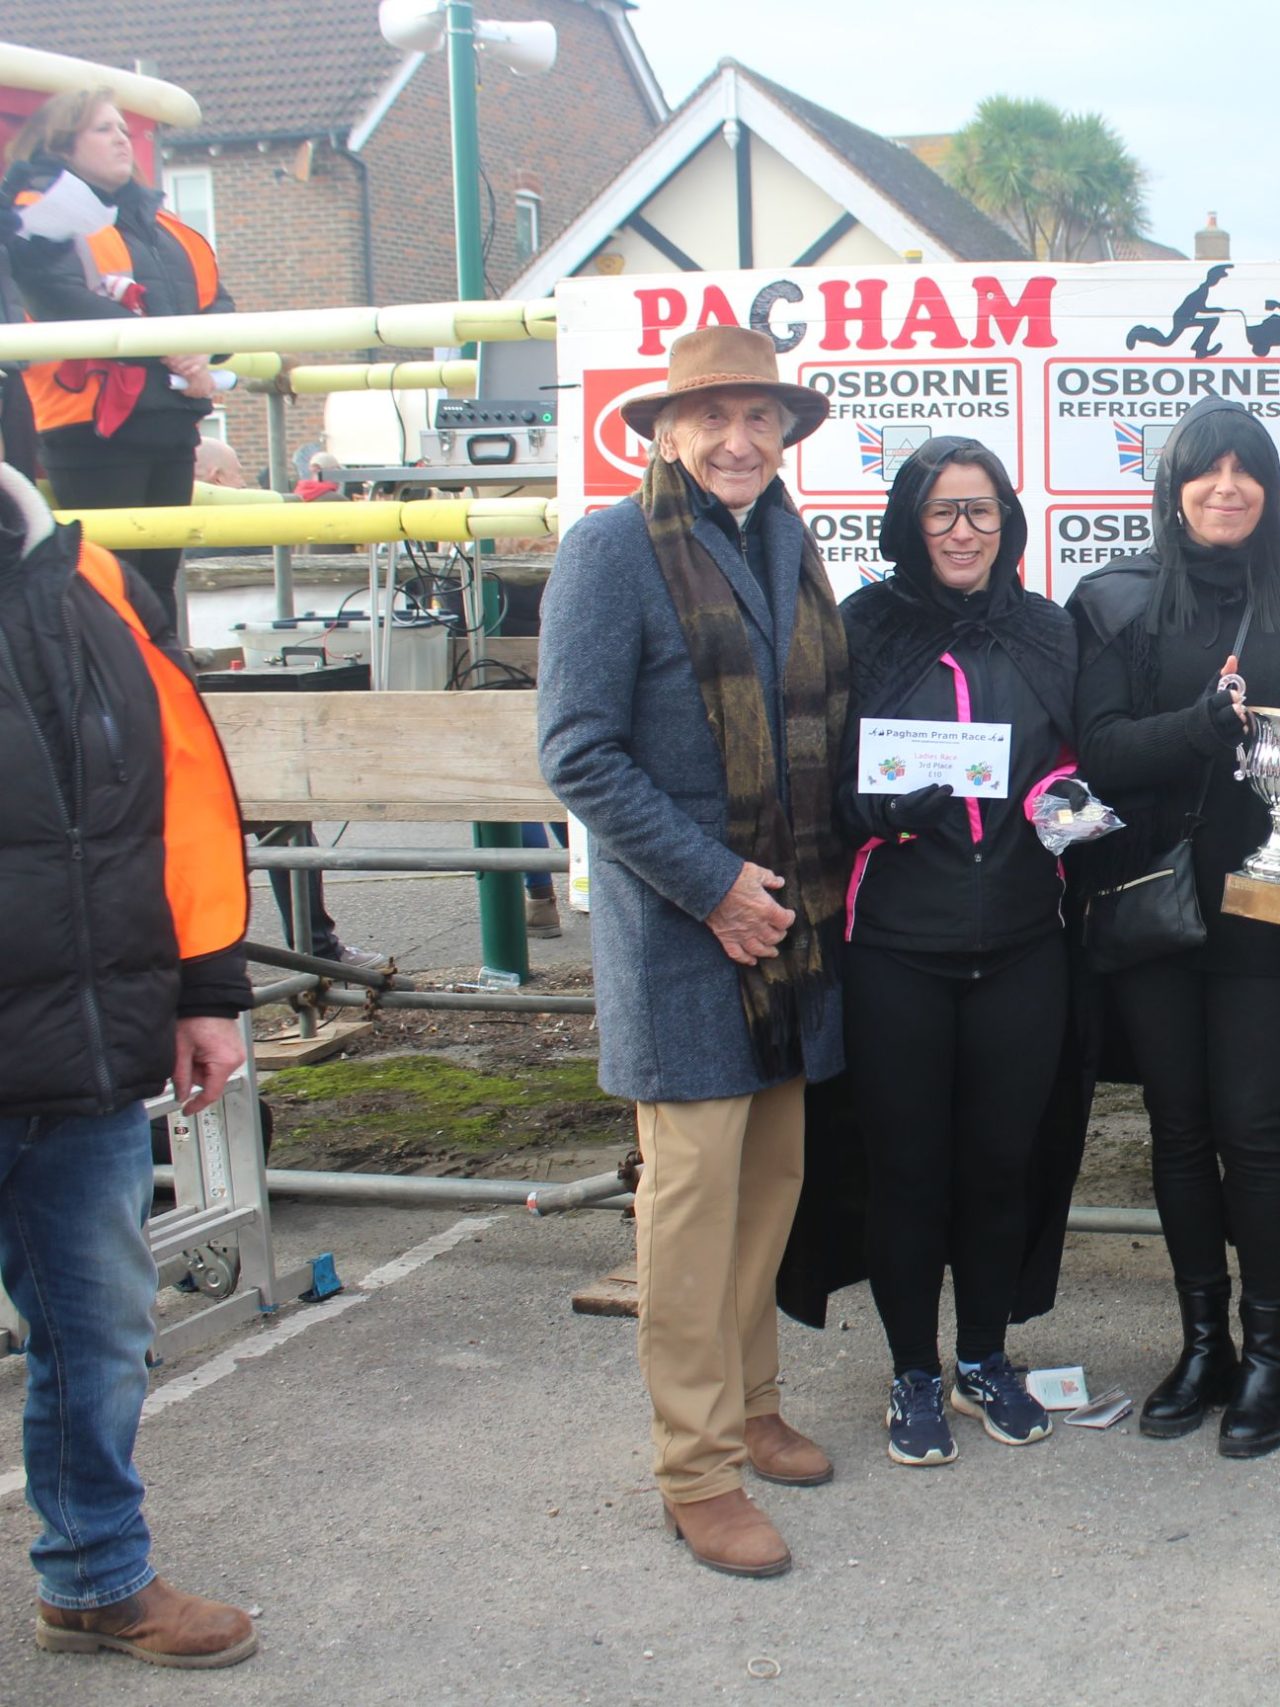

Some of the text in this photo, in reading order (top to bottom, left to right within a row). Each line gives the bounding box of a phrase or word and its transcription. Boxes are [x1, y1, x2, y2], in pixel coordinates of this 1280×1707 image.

[808, 369, 1009, 398] OSBORNE
[1057, 368, 1280, 396] OSBORNE
[827, 402, 1010, 419] EFRIGERATORS
[886, 729, 928, 739] Pagham
[931, 731, 958, 740] Pram
[961, 732, 986, 742] Race
[914, 752, 937, 760] Ladies
[919, 761, 953, 770] 3rd Place
